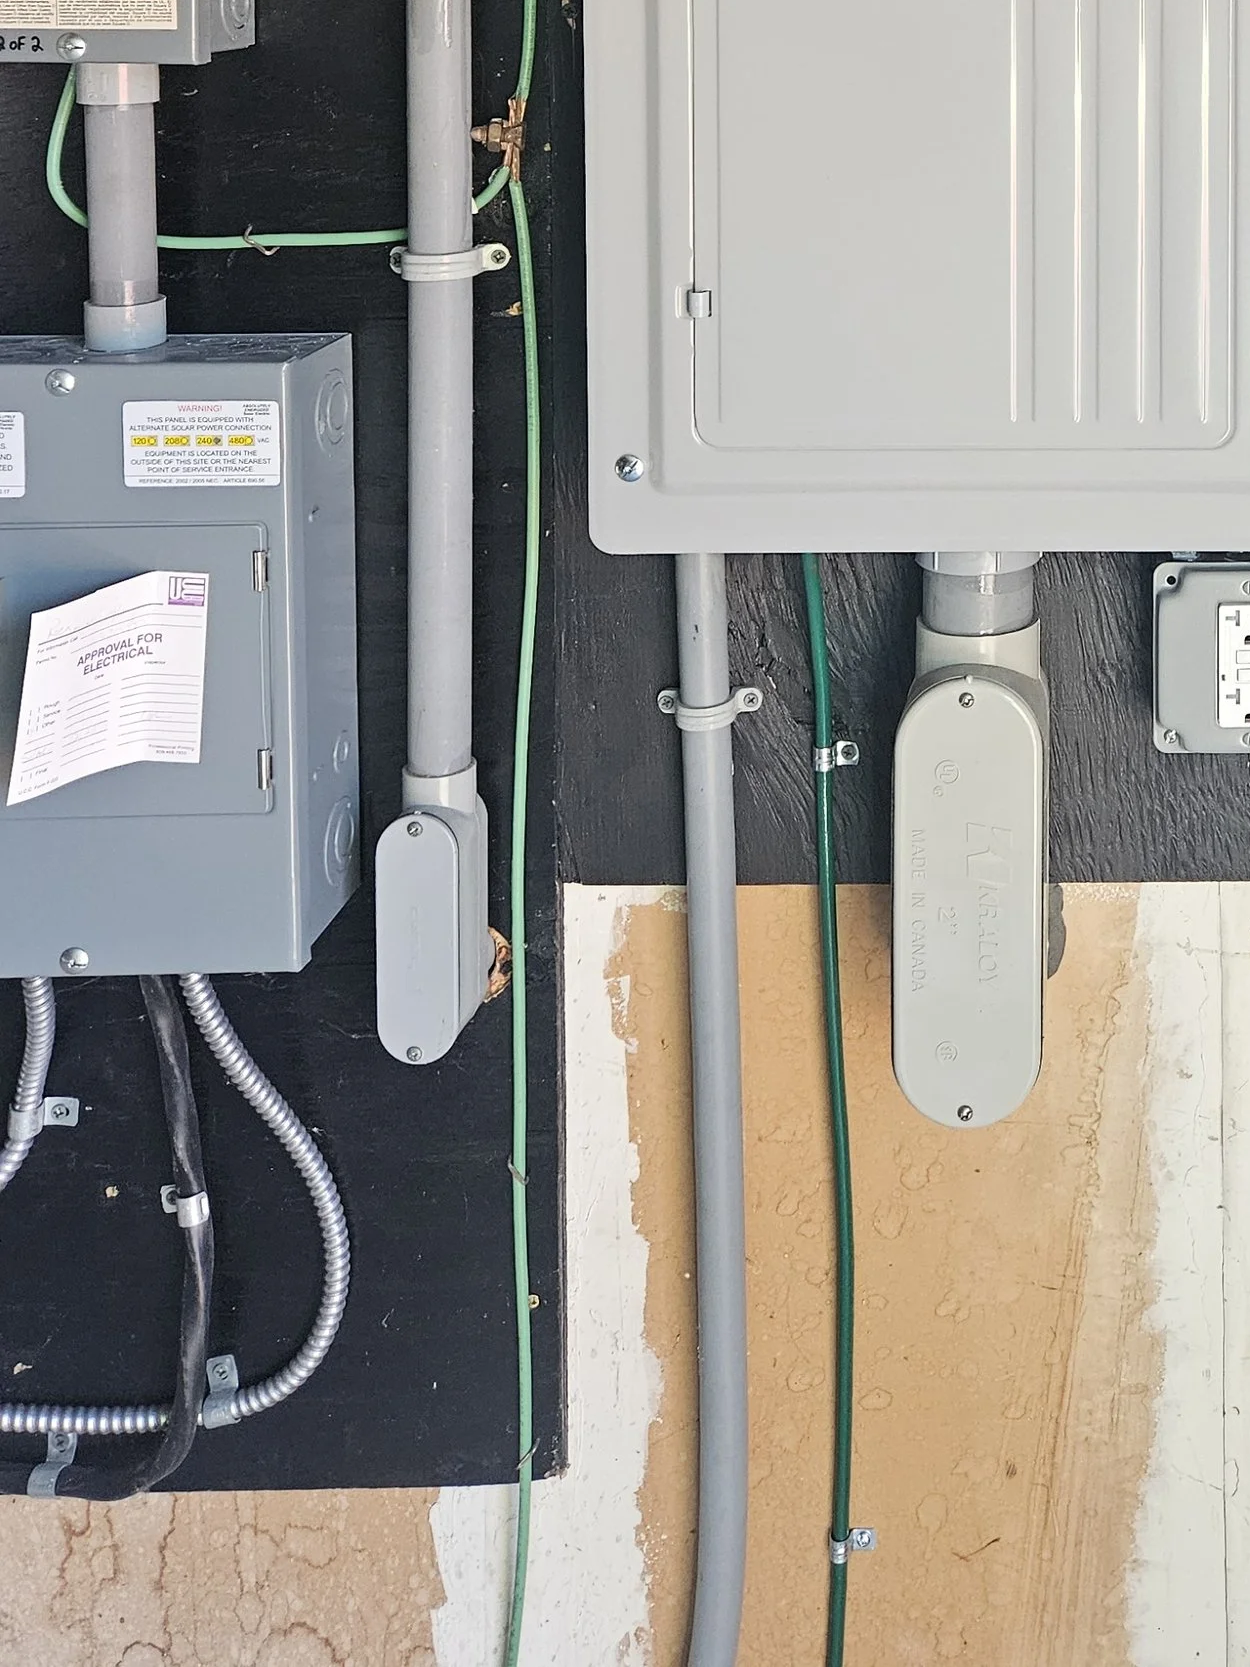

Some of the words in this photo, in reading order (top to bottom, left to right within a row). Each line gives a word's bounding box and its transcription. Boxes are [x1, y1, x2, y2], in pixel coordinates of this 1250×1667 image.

[31, 36, 44, 52] 2
[177, 405, 223, 413] WARNING!
[77, 638, 135, 666] APPROVAL
[137, 633, 163, 645] FOR
[83, 646, 154, 675] ELECTRICAL
[911, 829, 926, 879] MADE
[911, 892, 926, 908] IN
[978, 885, 999, 987] KRALOY
[911, 919, 927, 992] CANADA
